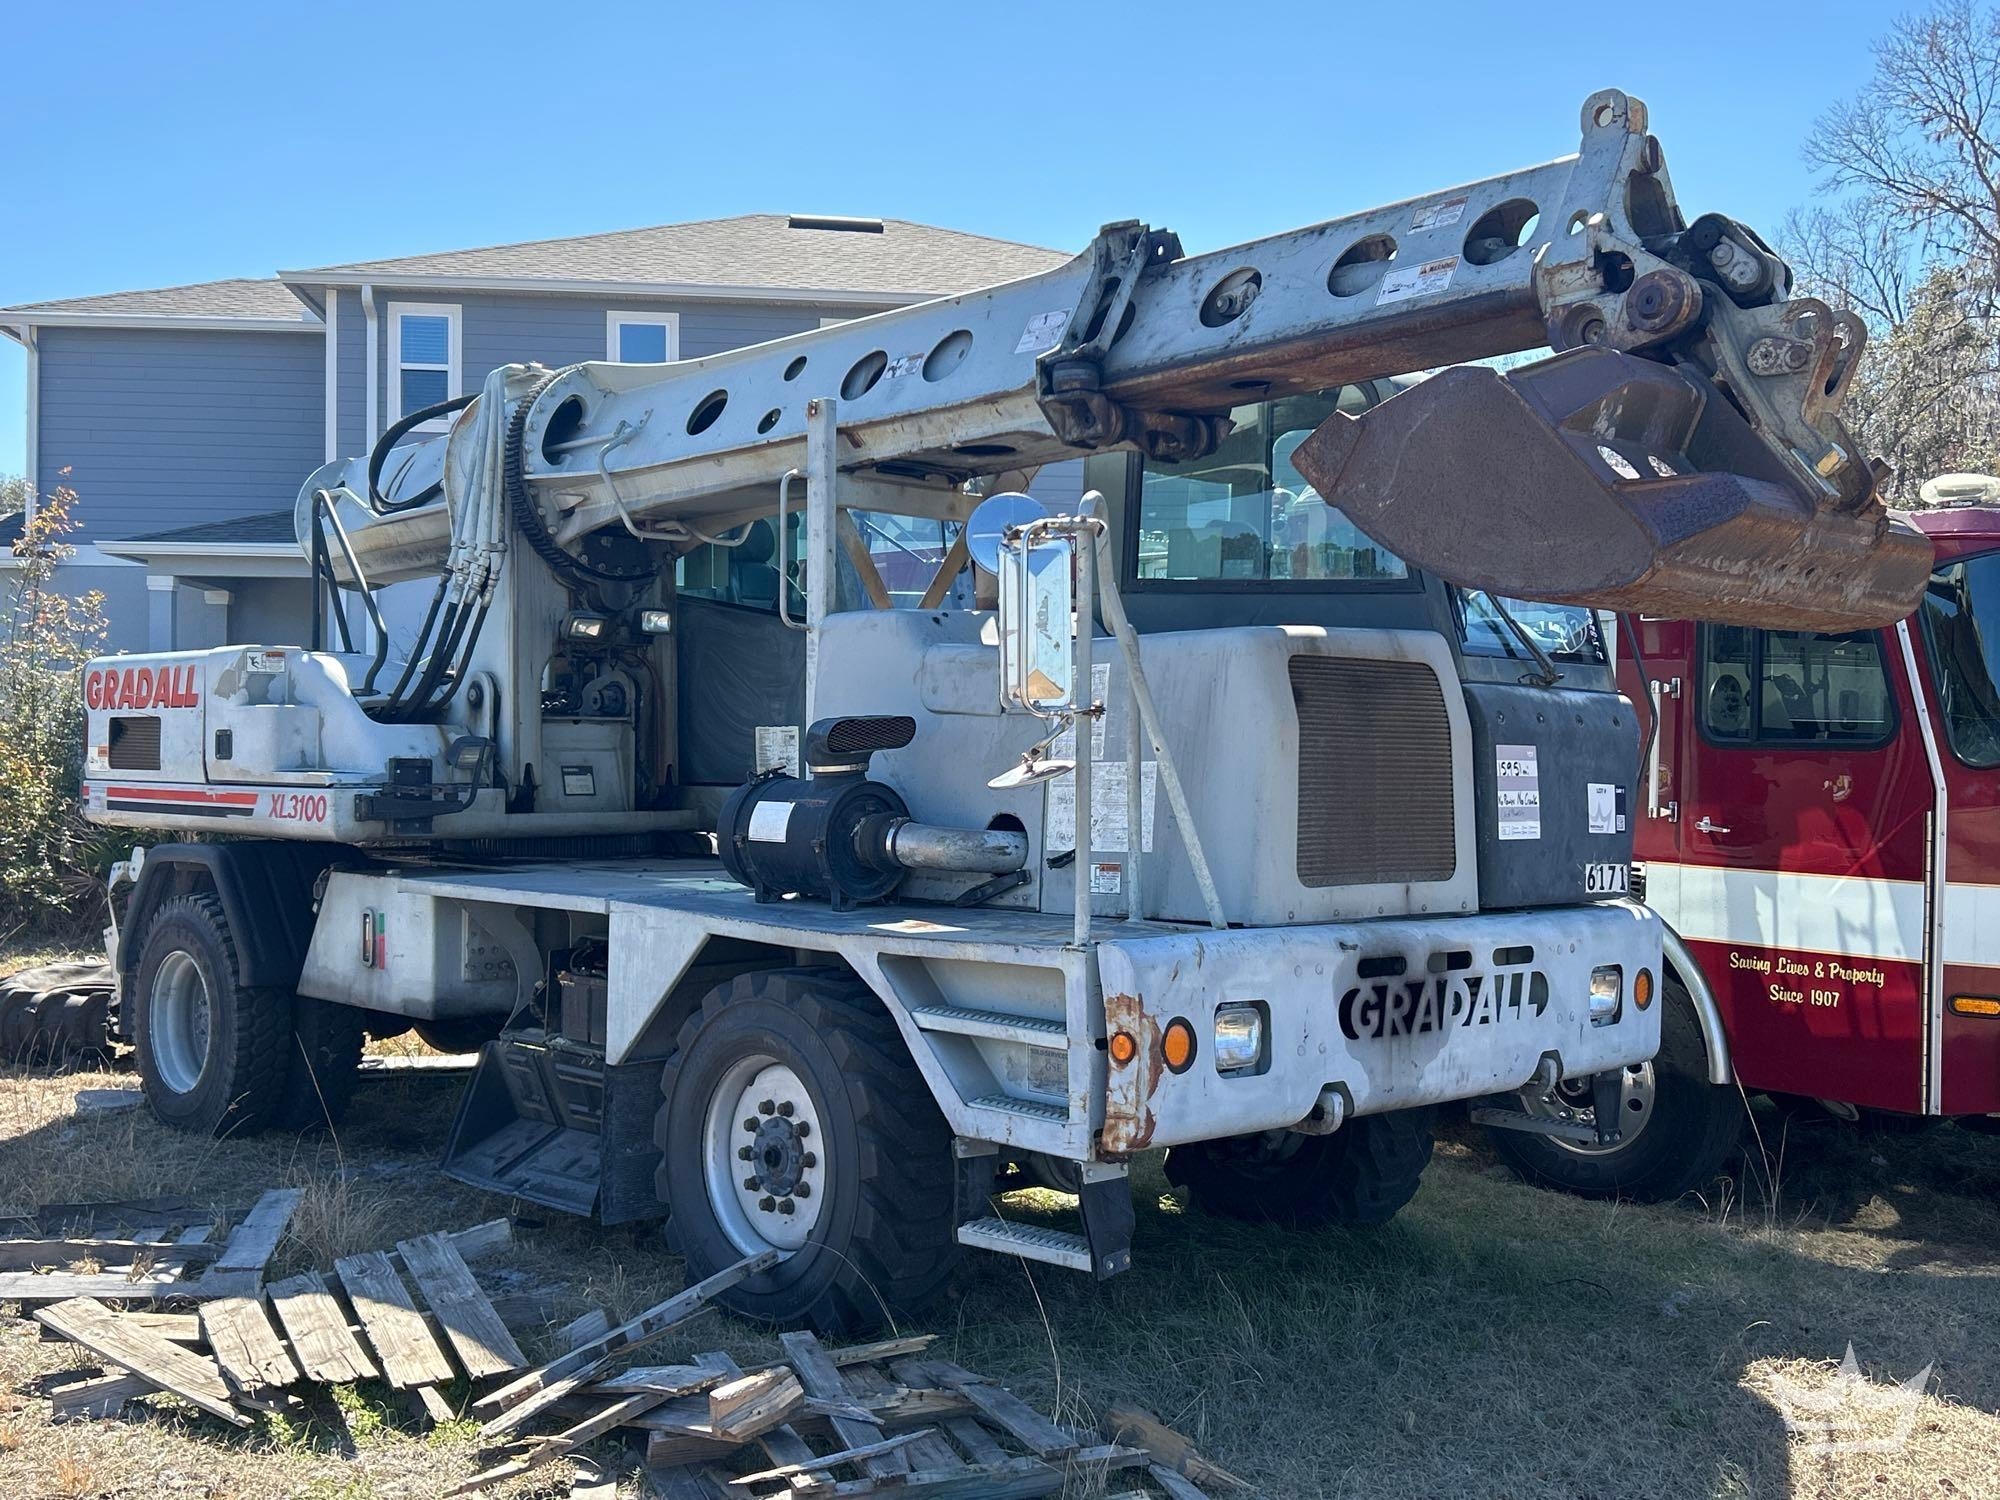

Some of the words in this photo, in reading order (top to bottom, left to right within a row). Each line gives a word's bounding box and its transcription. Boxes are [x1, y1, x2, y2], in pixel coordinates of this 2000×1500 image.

[86, 663, 199, 711] GRADALL
[268, 793, 327, 823] XL3100
[1586, 865, 1626, 891] 6171
[1729, 952, 1771, 975] Saving
[1775, 956, 1809, 977] Lives
[1814, 961, 1825, 979] &
[1829, 962, 1885, 988] Property
[1343, 971, 1544, 1040] GRADALL
[1769, 984, 1804, 1004] Since
[1810, 988, 1840, 1008] 1907
